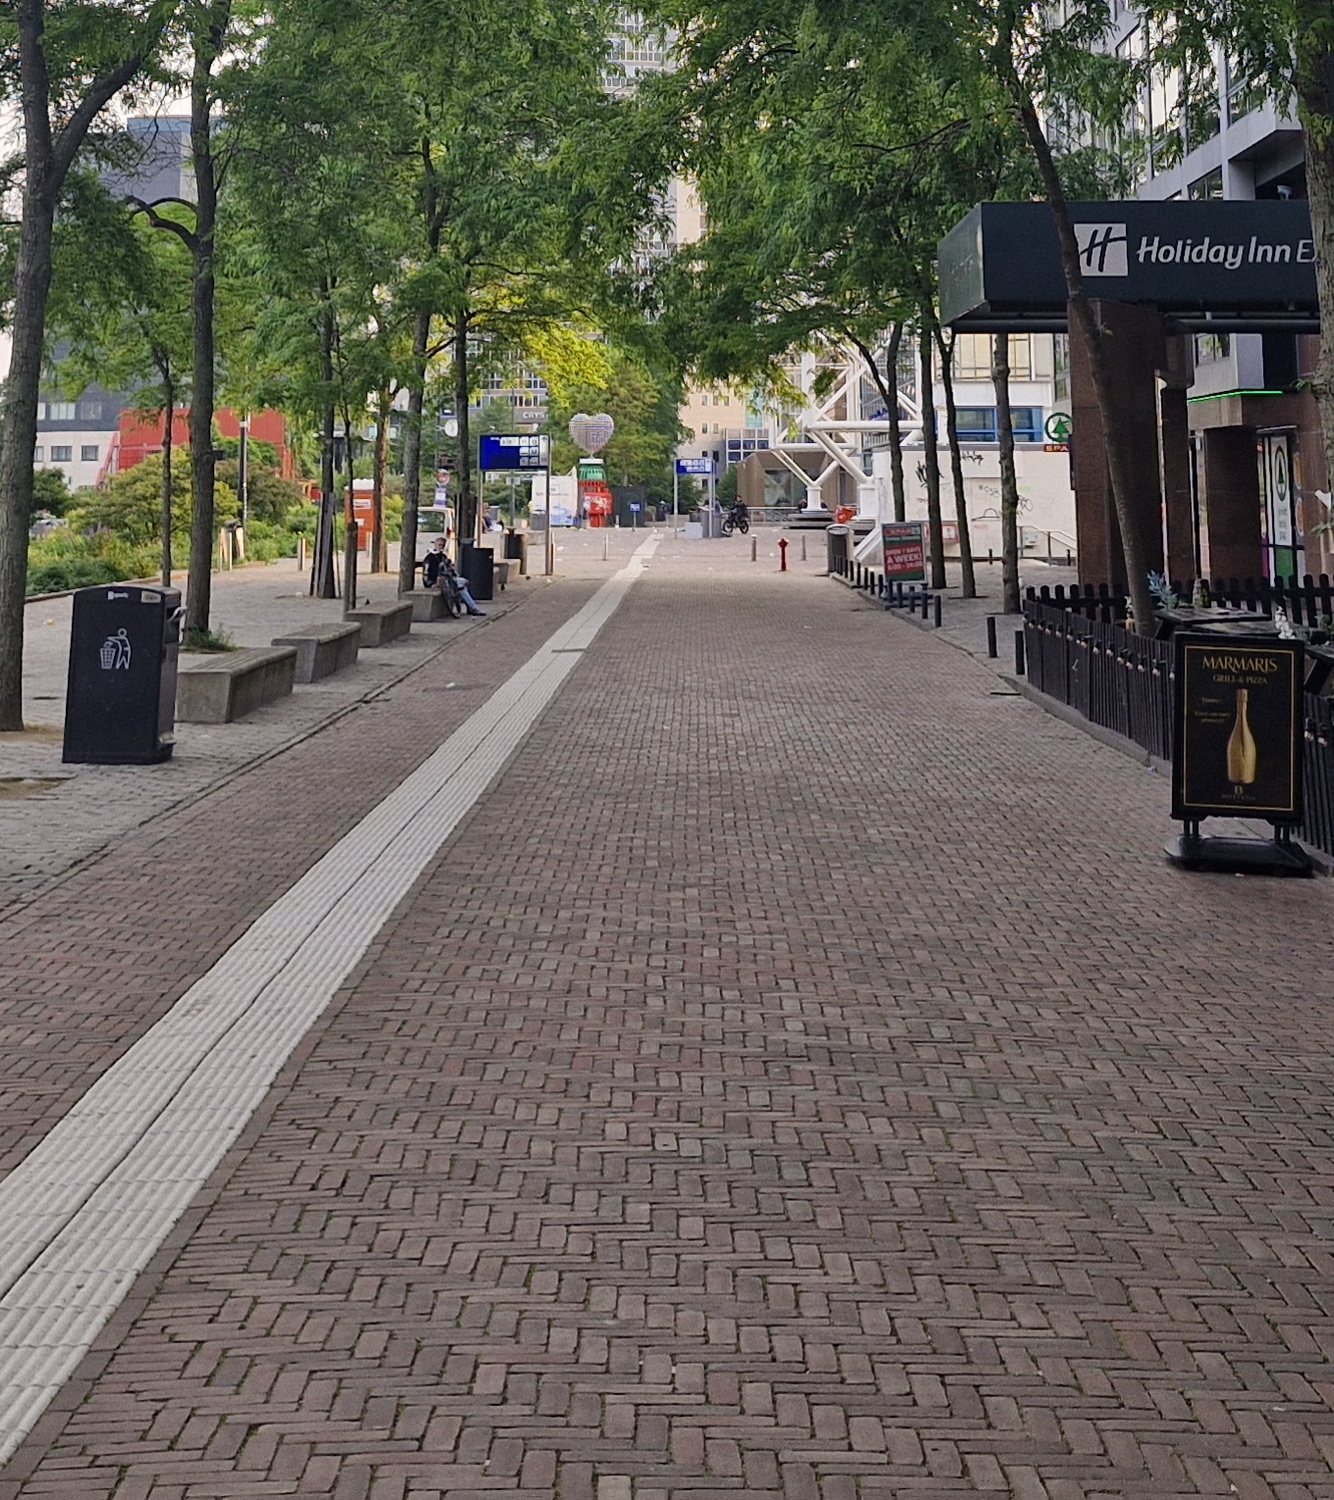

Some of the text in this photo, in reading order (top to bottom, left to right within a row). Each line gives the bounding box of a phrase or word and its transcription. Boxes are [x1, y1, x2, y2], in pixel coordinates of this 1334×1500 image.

[1136, 235, 1244, 271] Holiday
[1248, 236, 1290, 263] Inn
[887, 552, 922, 564] A WEEK!
[1202, 655, 1278, 674] MARMARIS
[1213, 674, 1235, 683] GRILL
[1246, 675, 1268, 685] PIZZA
